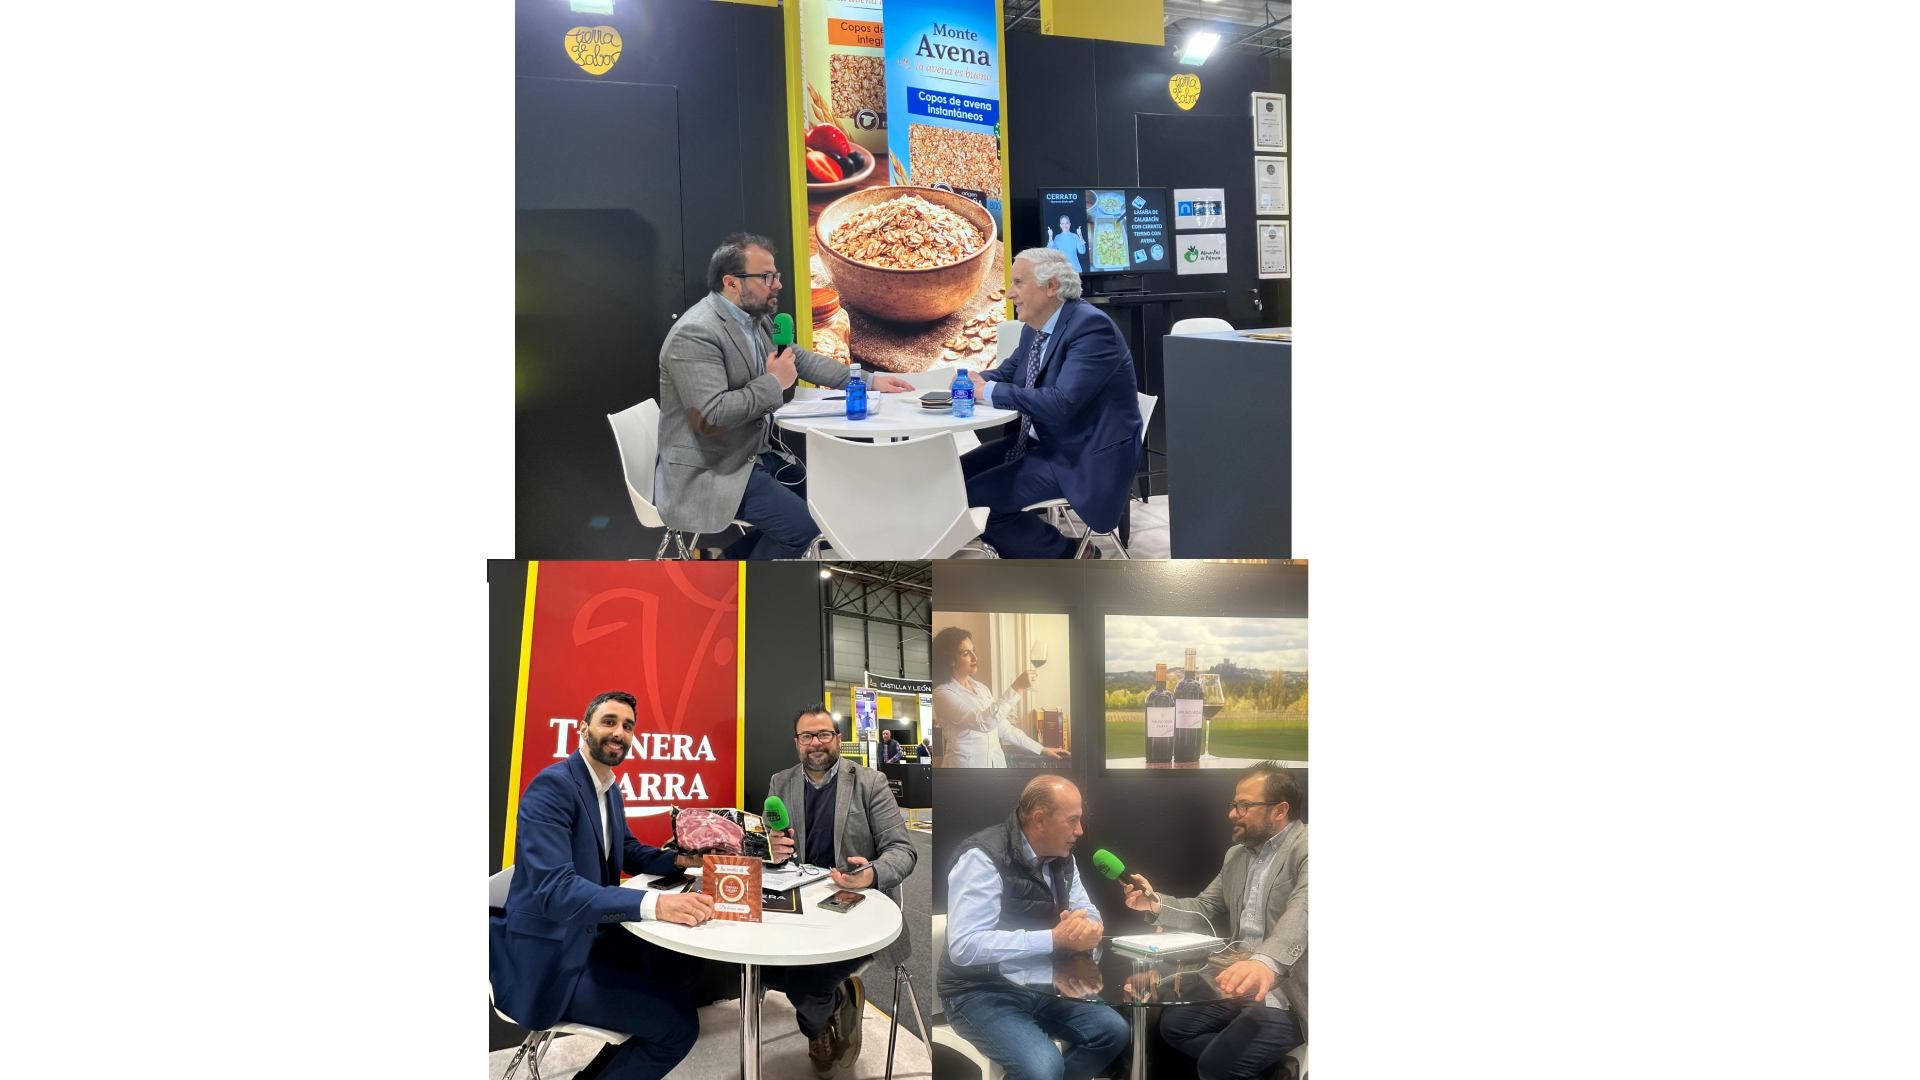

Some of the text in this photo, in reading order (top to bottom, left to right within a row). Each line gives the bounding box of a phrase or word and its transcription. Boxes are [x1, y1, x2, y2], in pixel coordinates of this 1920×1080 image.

[840, 22, 871, 33] Copos
[933, 22, 978, 41] Monte
[915, 33, 992, 66] Avena
[927, 64, 953, 75] avena
[918, 91, 992, 111] Copos de avena
[927, 104, 984, 121] instantáneos
[880, 682, 907, 691] CASTILLA
[912, 684, 932, 692] LEÓN
[549, 718, 717, 762] TNERA
[618, 772, 709, 801] ARRA
